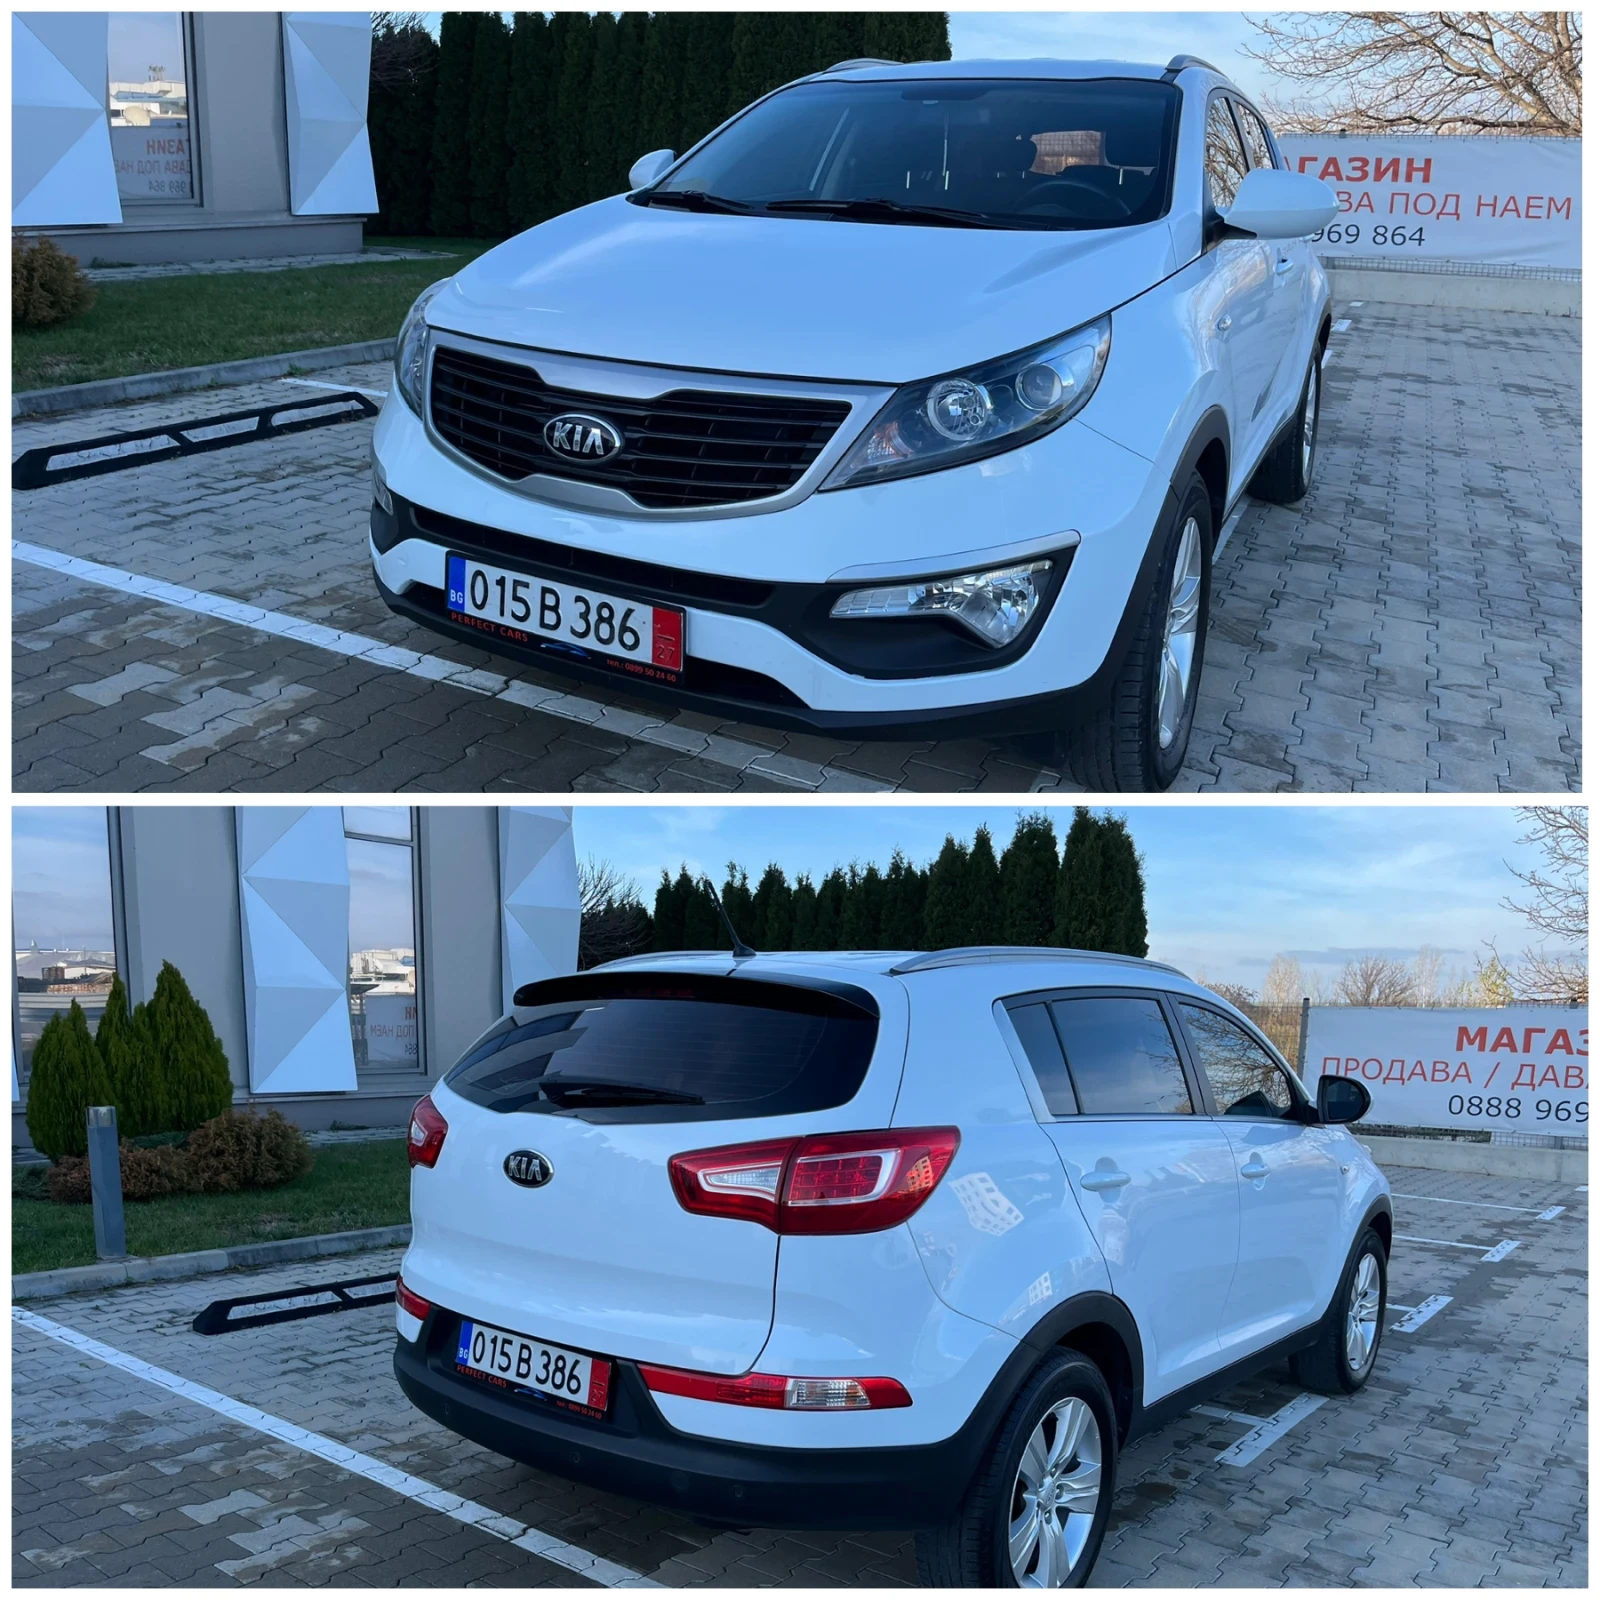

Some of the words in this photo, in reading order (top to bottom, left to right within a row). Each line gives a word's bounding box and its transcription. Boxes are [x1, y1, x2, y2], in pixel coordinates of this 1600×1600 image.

[1284, 155, 1432, 183] ГАЗИН
[1336, 190, 1375, 213] ВА
[1388, 192, 1460, 221] ПОД
[1475, 194, 1573, 220] НАЕМ
[1372, 225, 1425, 246] 864
[553, 421, 604, 455] KIA
[450, 589, 464, 604] BG
[451, 611, 496, 632] PERFECT
[500, 627, 528, 642] CARS
[624, 662, 643, 674] 0899
[644, 667, 655, 677] 50
[655, 670, 666, 679] 24
[1321, 1057, 1472, 1086] ПРОДАВА
[1510, 1063, 1588, 1092] ДАВ
[1448, 1094, 1521, 1119] 0888
[1535, 1099, 1588, 1123] 969
[509, 1155, 542, 1181] KIA
[458, 1347, 469, 1359] BG
[456, 1365, 487, 1380] PERFECT
[488, 1375, 507, 1388] CARS
